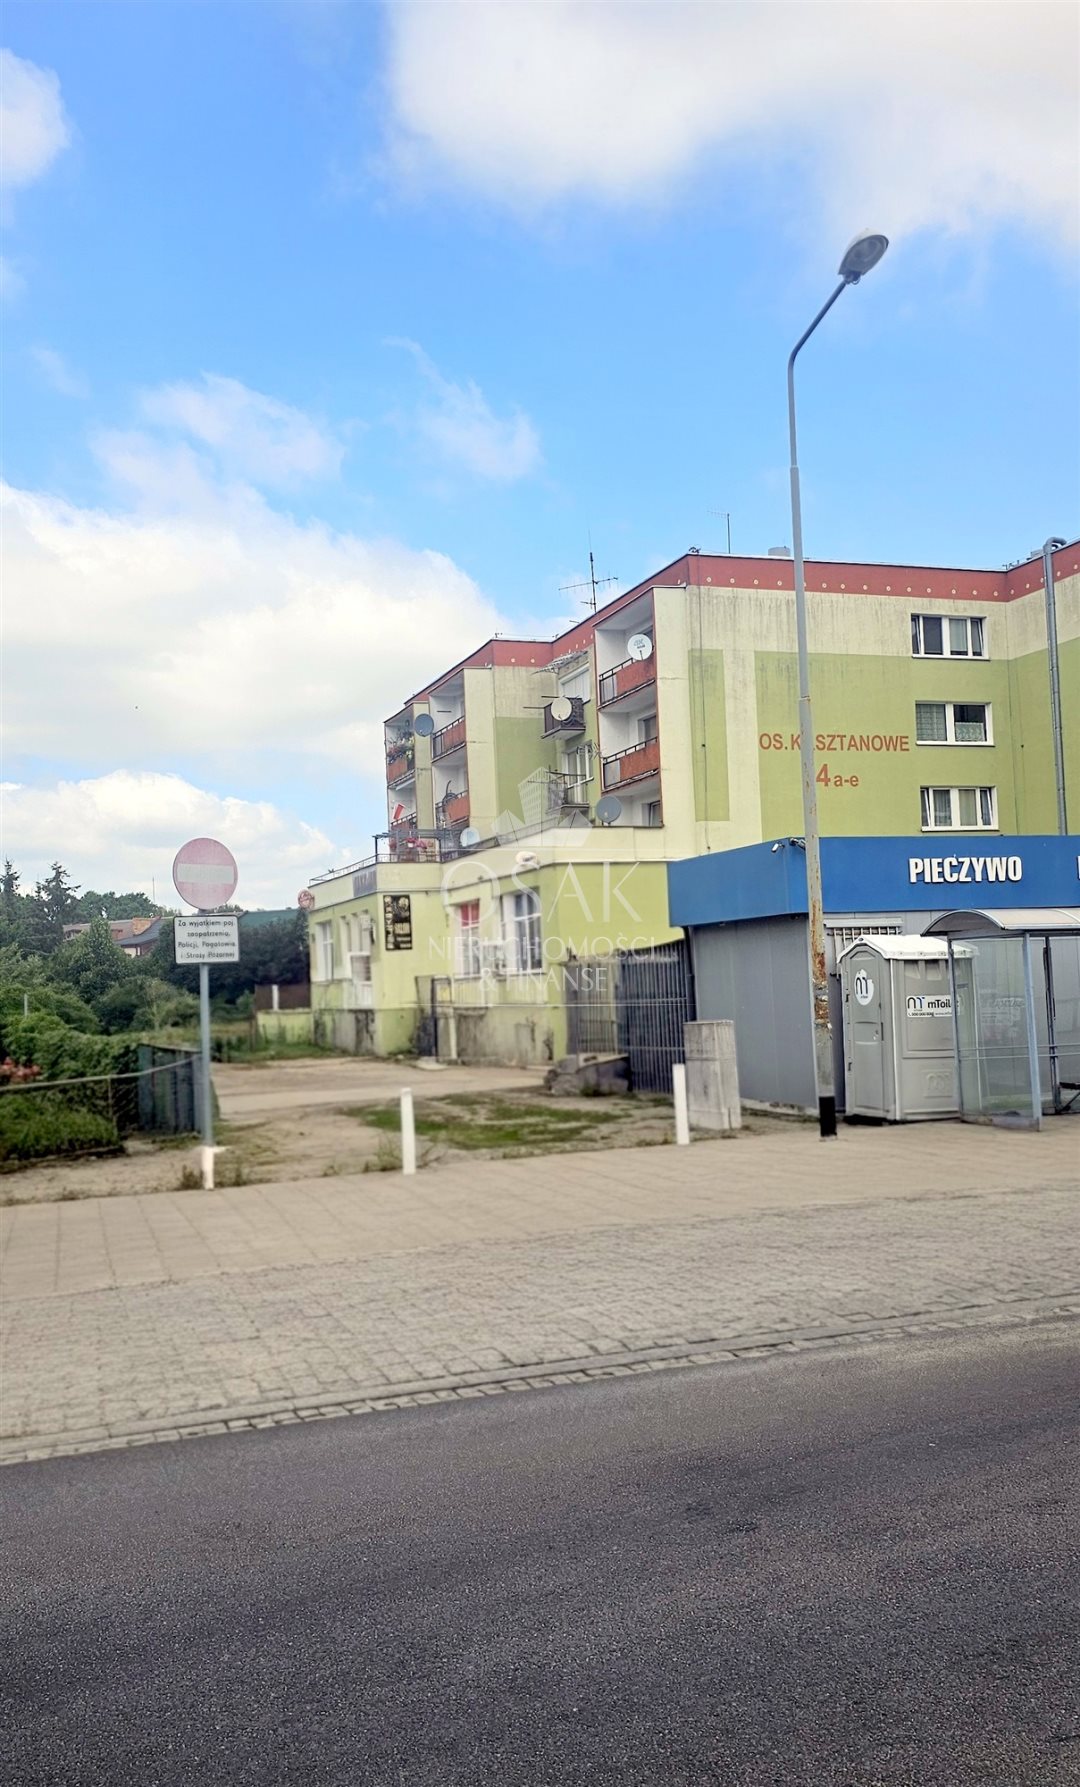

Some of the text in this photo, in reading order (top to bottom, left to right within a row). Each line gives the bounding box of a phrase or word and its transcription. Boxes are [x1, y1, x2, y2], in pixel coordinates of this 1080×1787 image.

[816, 763, 859, 787] 4 a-e
[909, 856, 1023, 883] PIECZYWO
